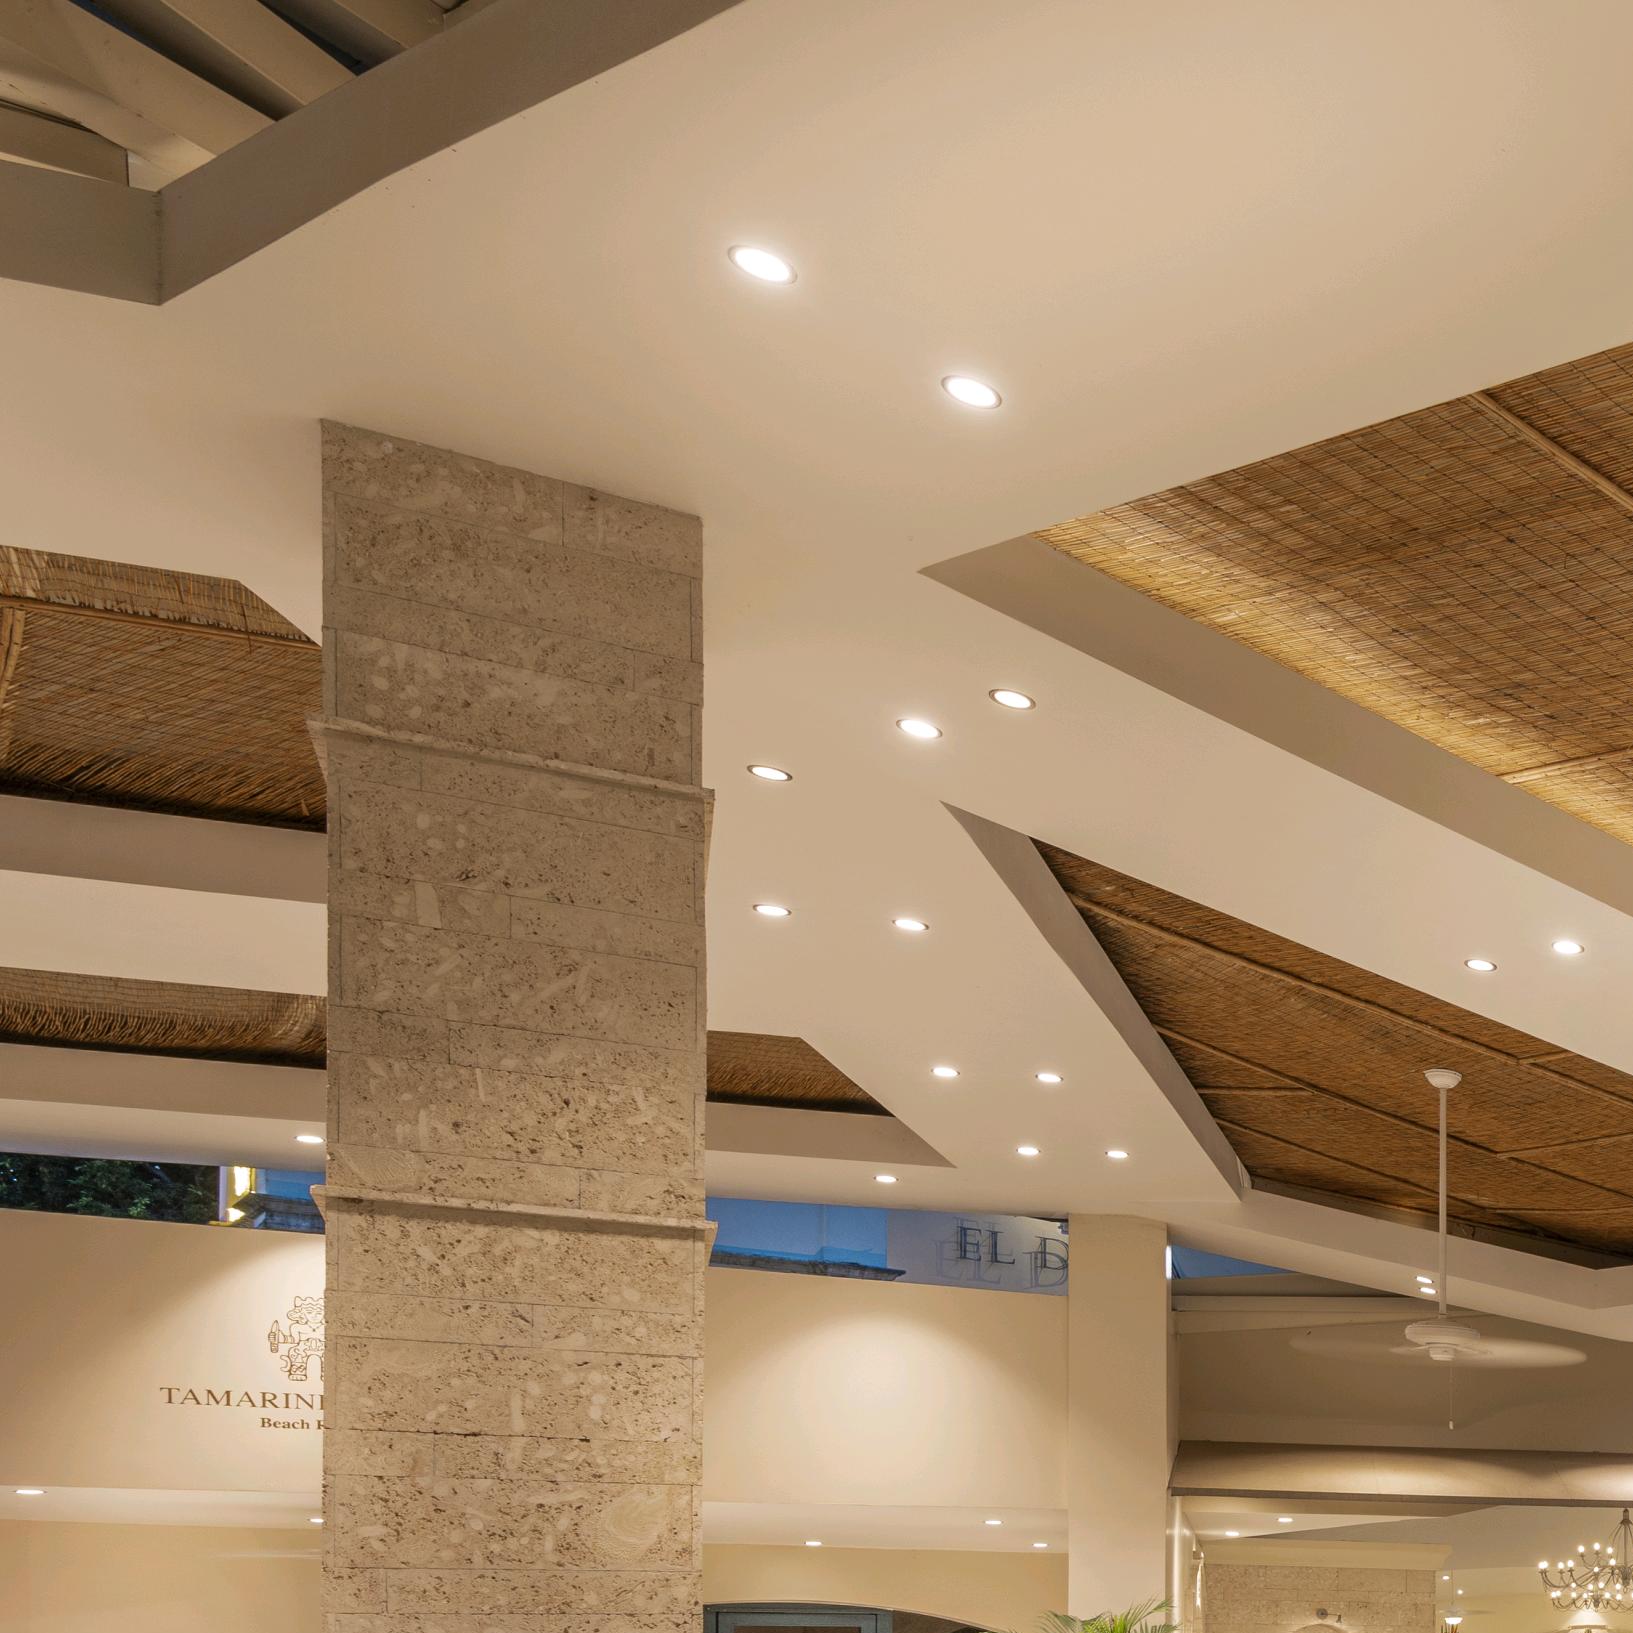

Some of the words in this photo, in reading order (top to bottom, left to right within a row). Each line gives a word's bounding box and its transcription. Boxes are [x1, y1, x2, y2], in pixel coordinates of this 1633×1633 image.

[957, 1225, 1015, 1265] EL
[159, 1386, 324, 1411] TAMARIN
[260, 1417, 310, 1430] Beach
